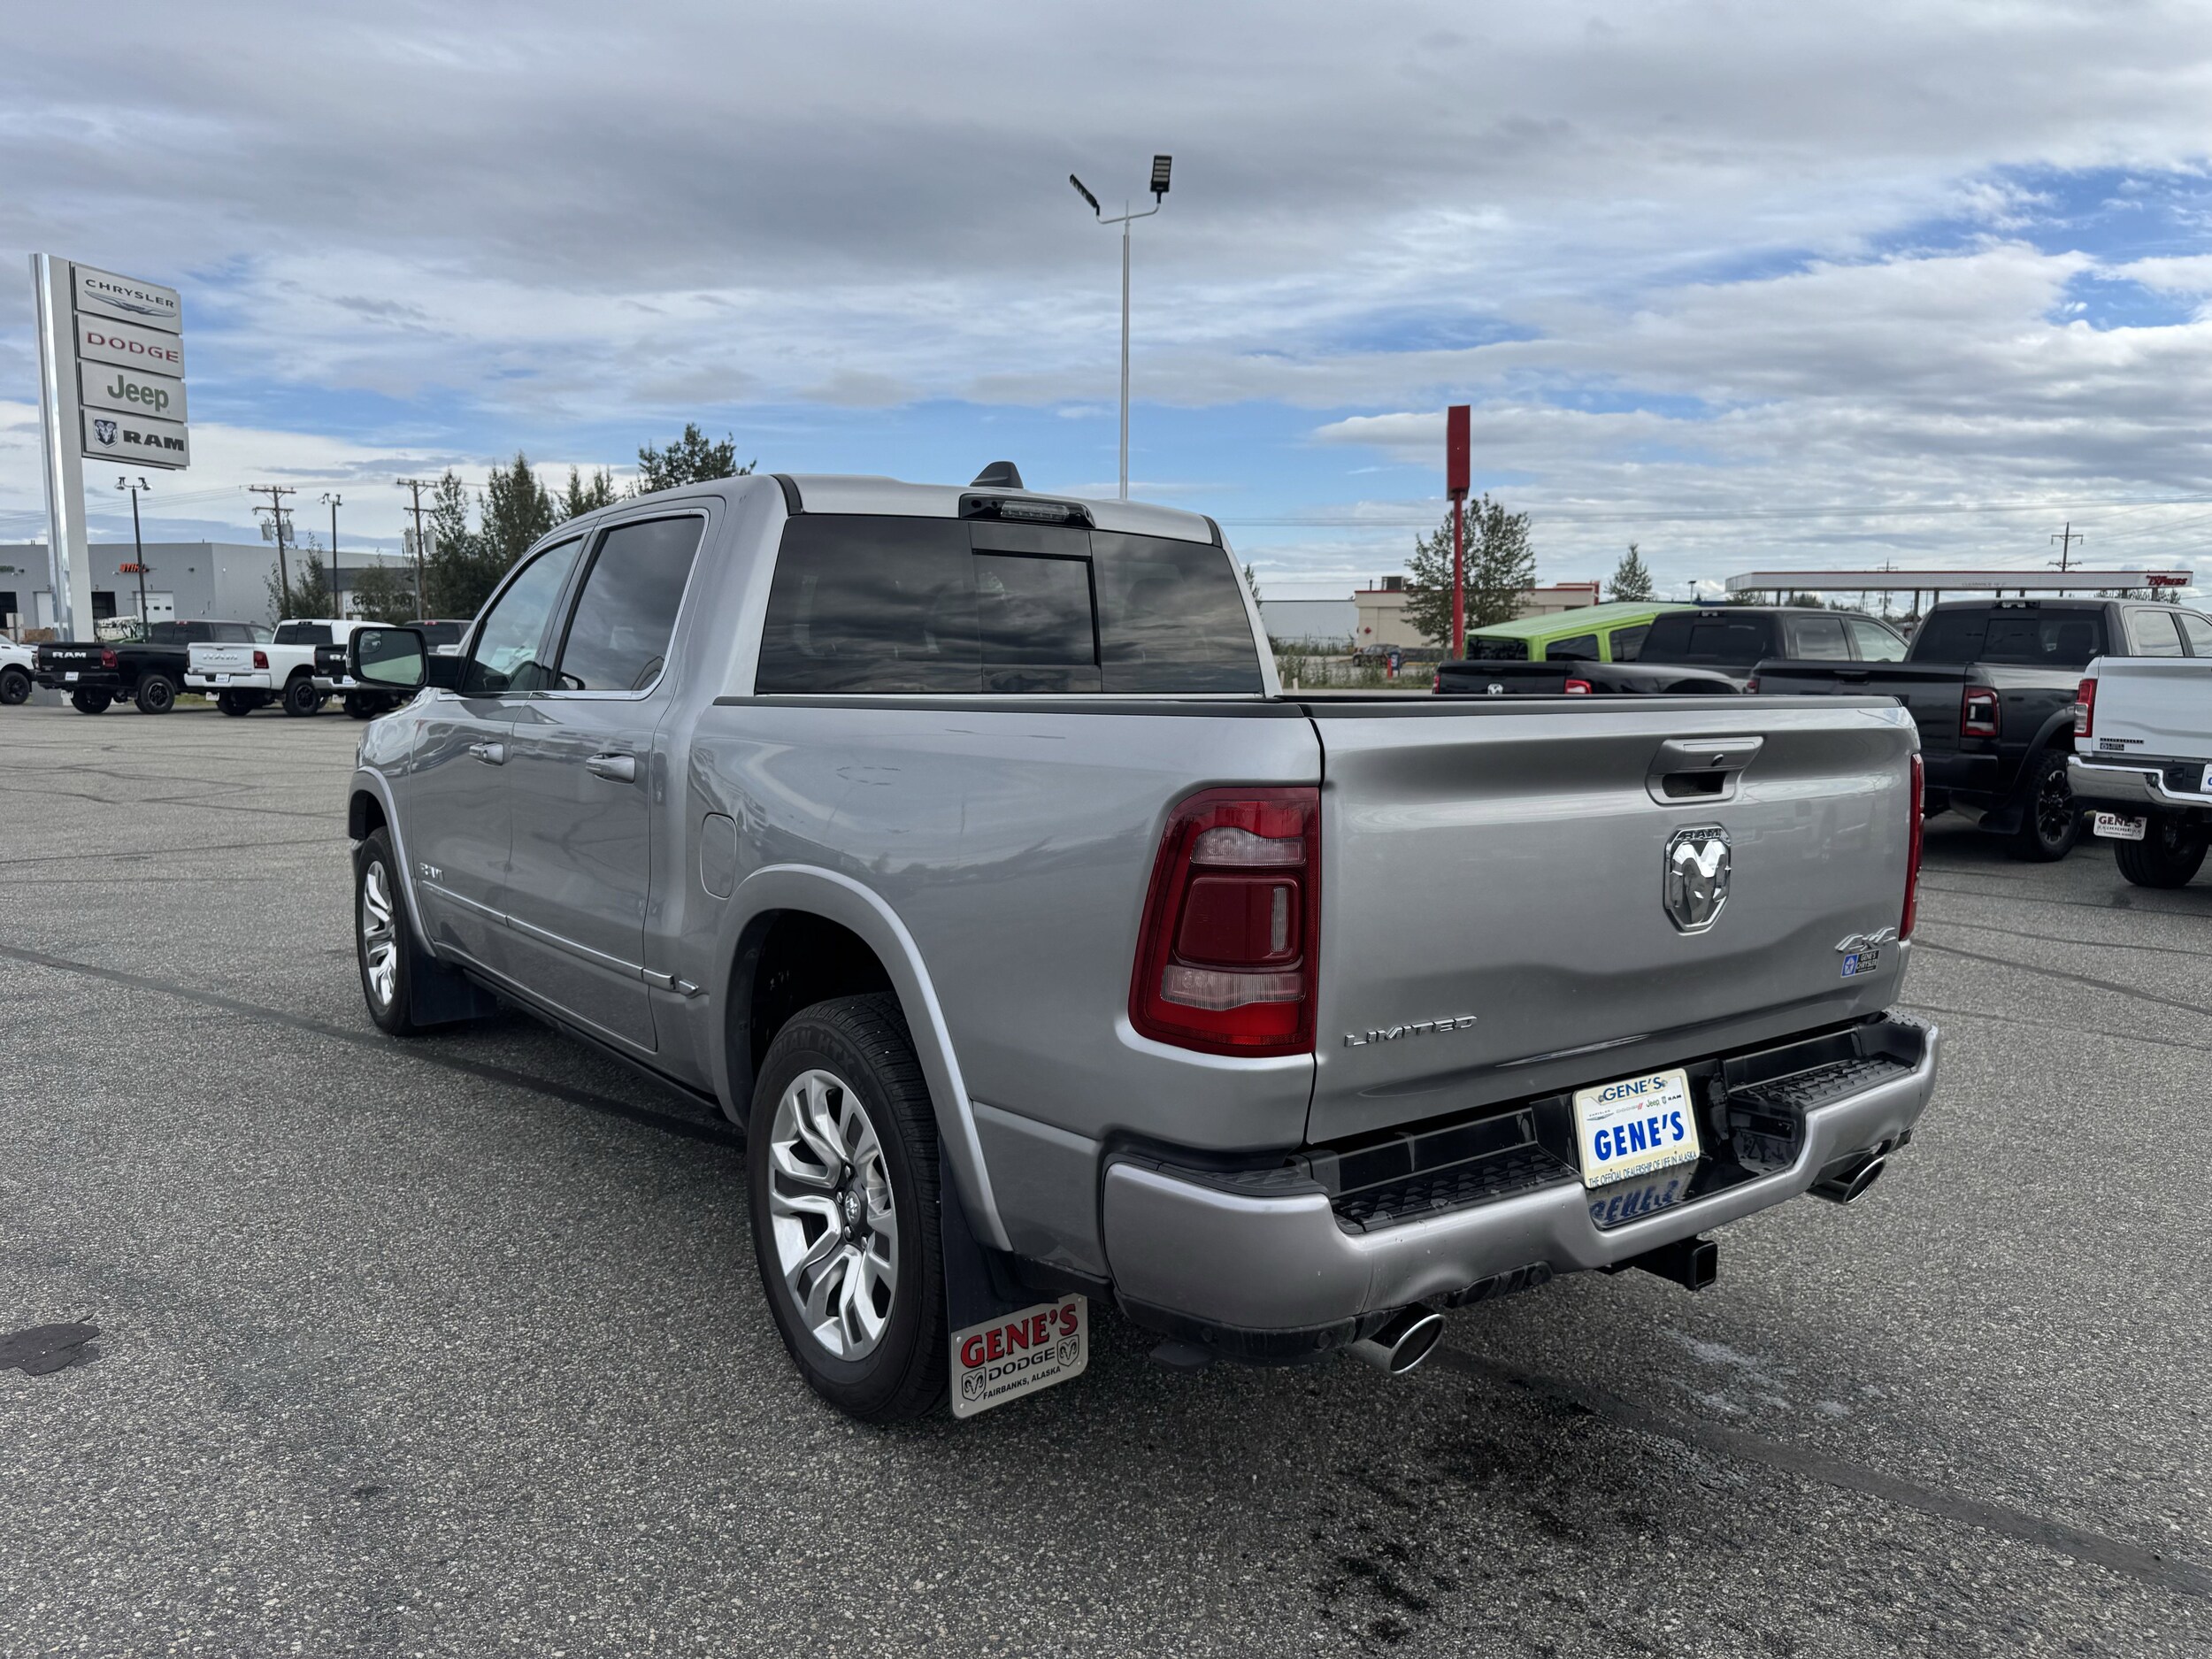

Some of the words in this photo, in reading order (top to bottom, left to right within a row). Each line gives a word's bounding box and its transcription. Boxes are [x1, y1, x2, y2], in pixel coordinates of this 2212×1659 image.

[85, 279, 174, 309] CHRYSLER
[87, 331, 179, 364] DODGE
[107, 374, 169, 412] Jeep
[123, 429, 184, 451] RAM
[1344, 1015, 1478, 1048] LIMITED
[1603, 1076, 1663, 1102] GENE'S
[1646, 1099, 1660, 1108] Jeep
[1594, 1110, 1685, 1161] GENE'S
[1589, 1175, 1600, 1187] THE
[1601, 1171, 1622, 1186] OFFICIAL
[1623, 1162, 1652, 1179] DEALERSHIP
[1653, 1161, 1661, 1170] OF
[1662, 1156, 1671, 1168] LIFE
[1671, 1155, 1678, 1165] IN
[1678, 1150, 1697, 1164] ALASKA
[960, 1303, 1079, 1368] GENE'S
[988, 1346, 1056, 1380] DODGE
[983, 1376, 1030, 1400] FAIRBANKS,
[1031, 1365, 1061, 1382] ALASKA
